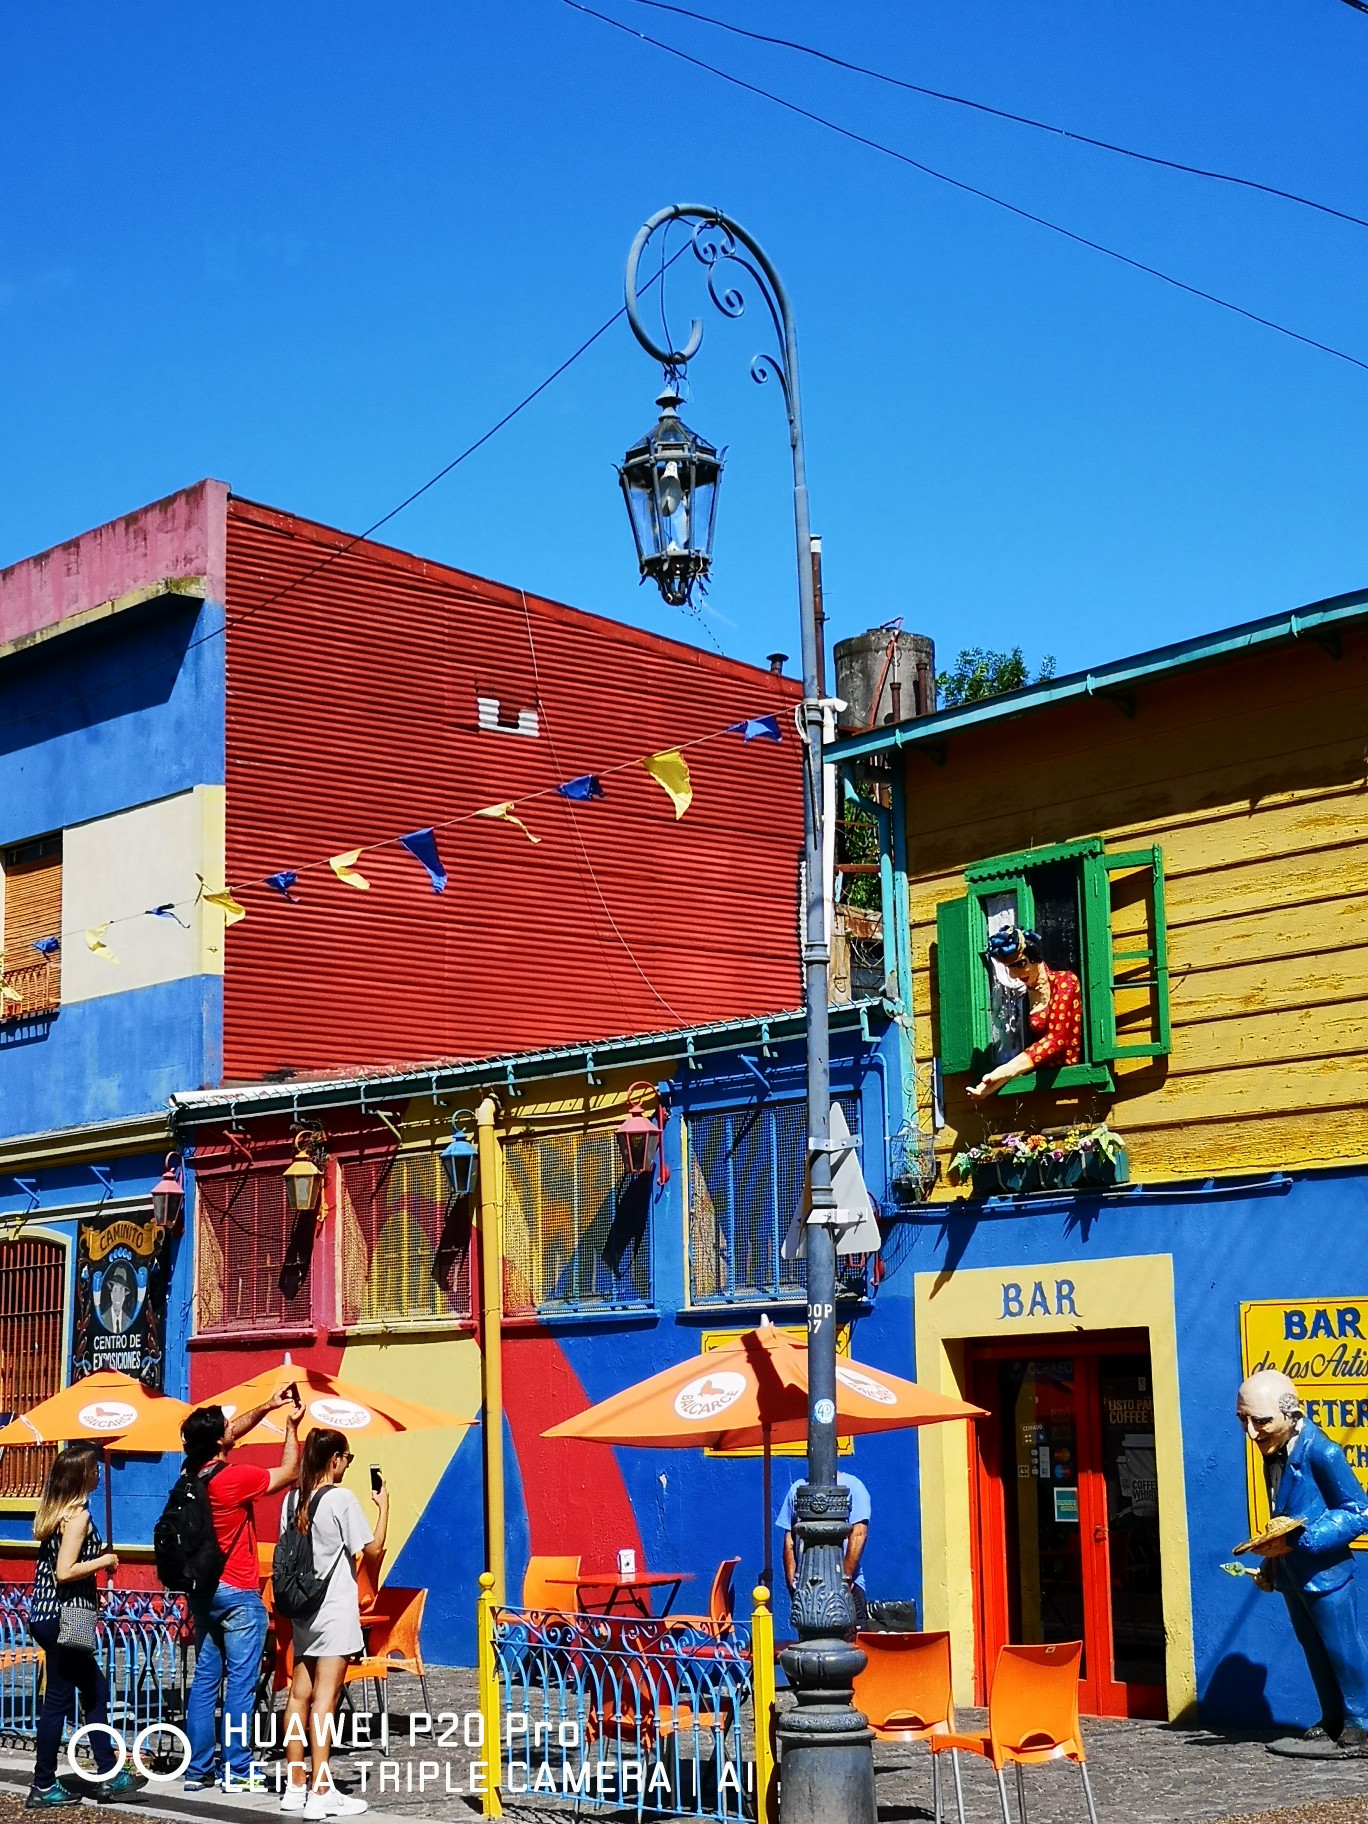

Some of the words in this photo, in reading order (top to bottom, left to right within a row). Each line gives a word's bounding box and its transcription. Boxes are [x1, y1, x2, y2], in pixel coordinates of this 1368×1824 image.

[100, 1223, 144, 1250] CAMINITO
[995, 1279, 1084, 1320] BAR
[1283, 1307, 1367, 1341] BAR
[94, 1335, 128, 1351] CENTRO
[129, 1334, 142, 1348] DE
[1027, 1361, 1073, 1375] CORREO
[1281, 1349, 1311, 1379] los
[681, 1389, 739, 1416] BALCARCE
[1108, 1399, 1135, 1411] LISTO
[1298, 1398, 1368, 1428] ETER
[83, 1413, 134, 1428] BALCARCE
[1109, 1410, 1149, 1424] COFFEE
